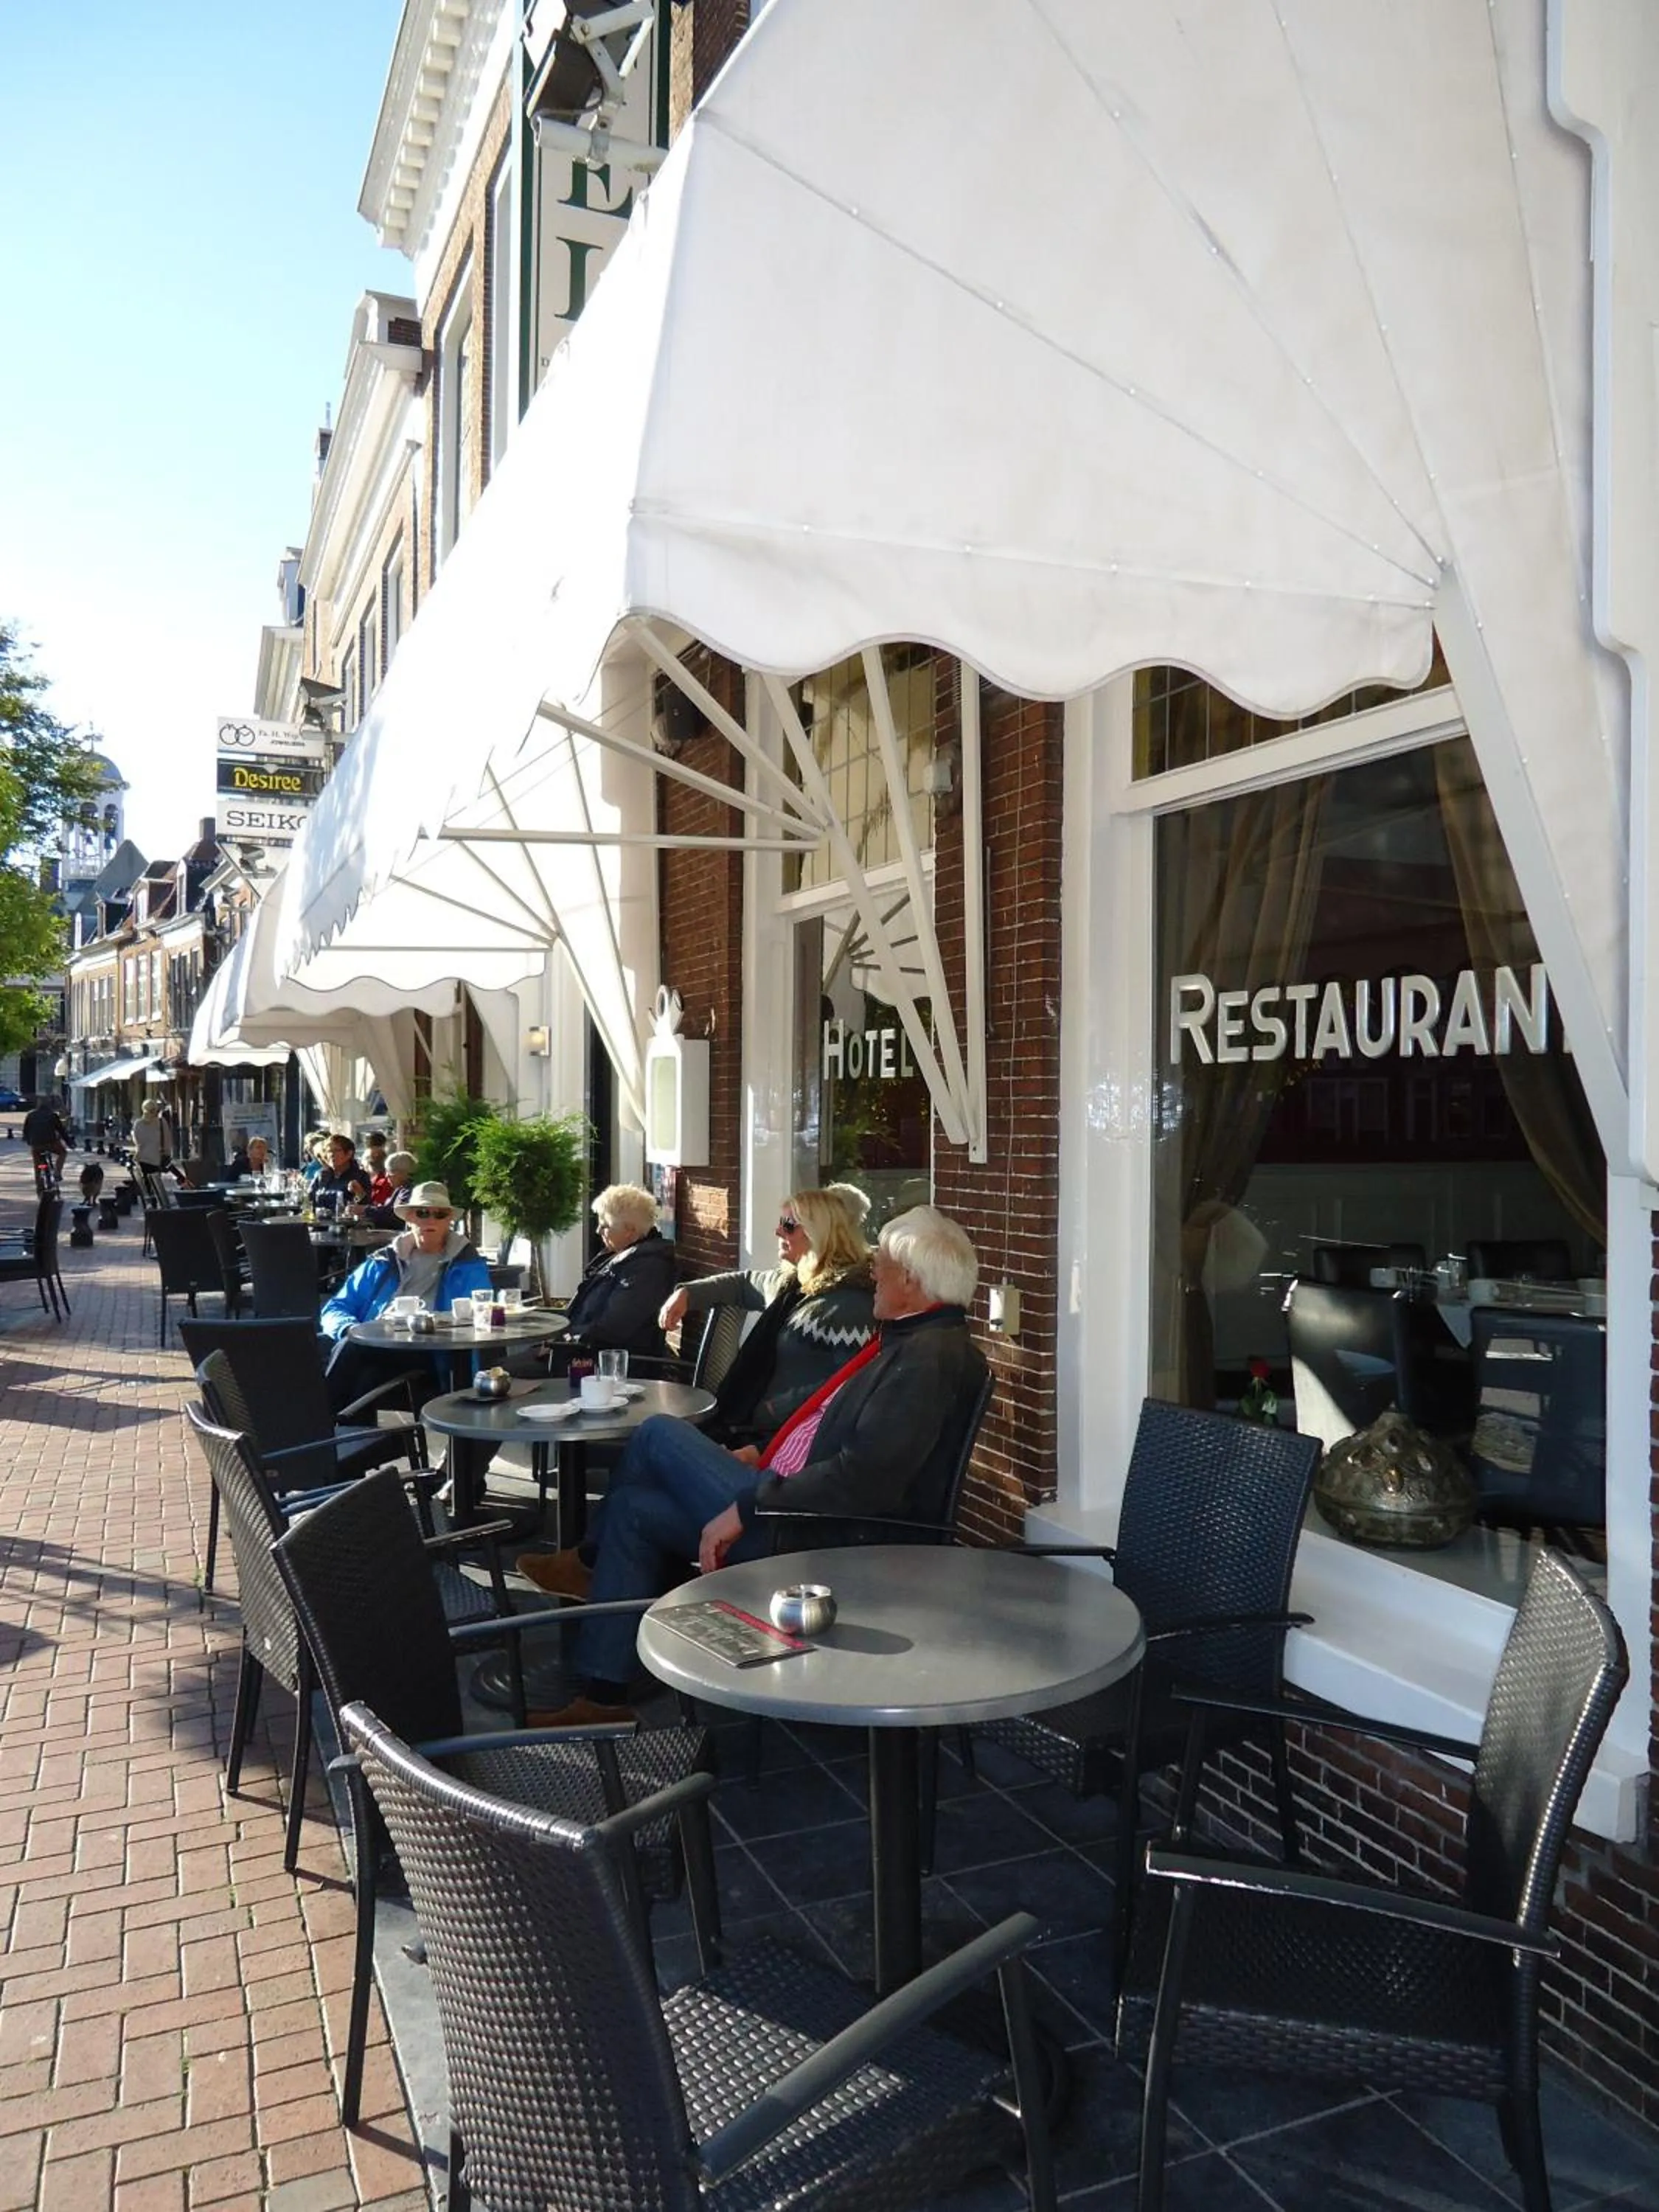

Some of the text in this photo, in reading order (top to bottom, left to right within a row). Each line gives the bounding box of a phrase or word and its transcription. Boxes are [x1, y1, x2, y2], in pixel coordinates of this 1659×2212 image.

[234, 767, 302, 791] Desiree
[1170, 963, 1572, 1065] RESTAURAN
[824, 1019, 914, 1080] HOTEL
